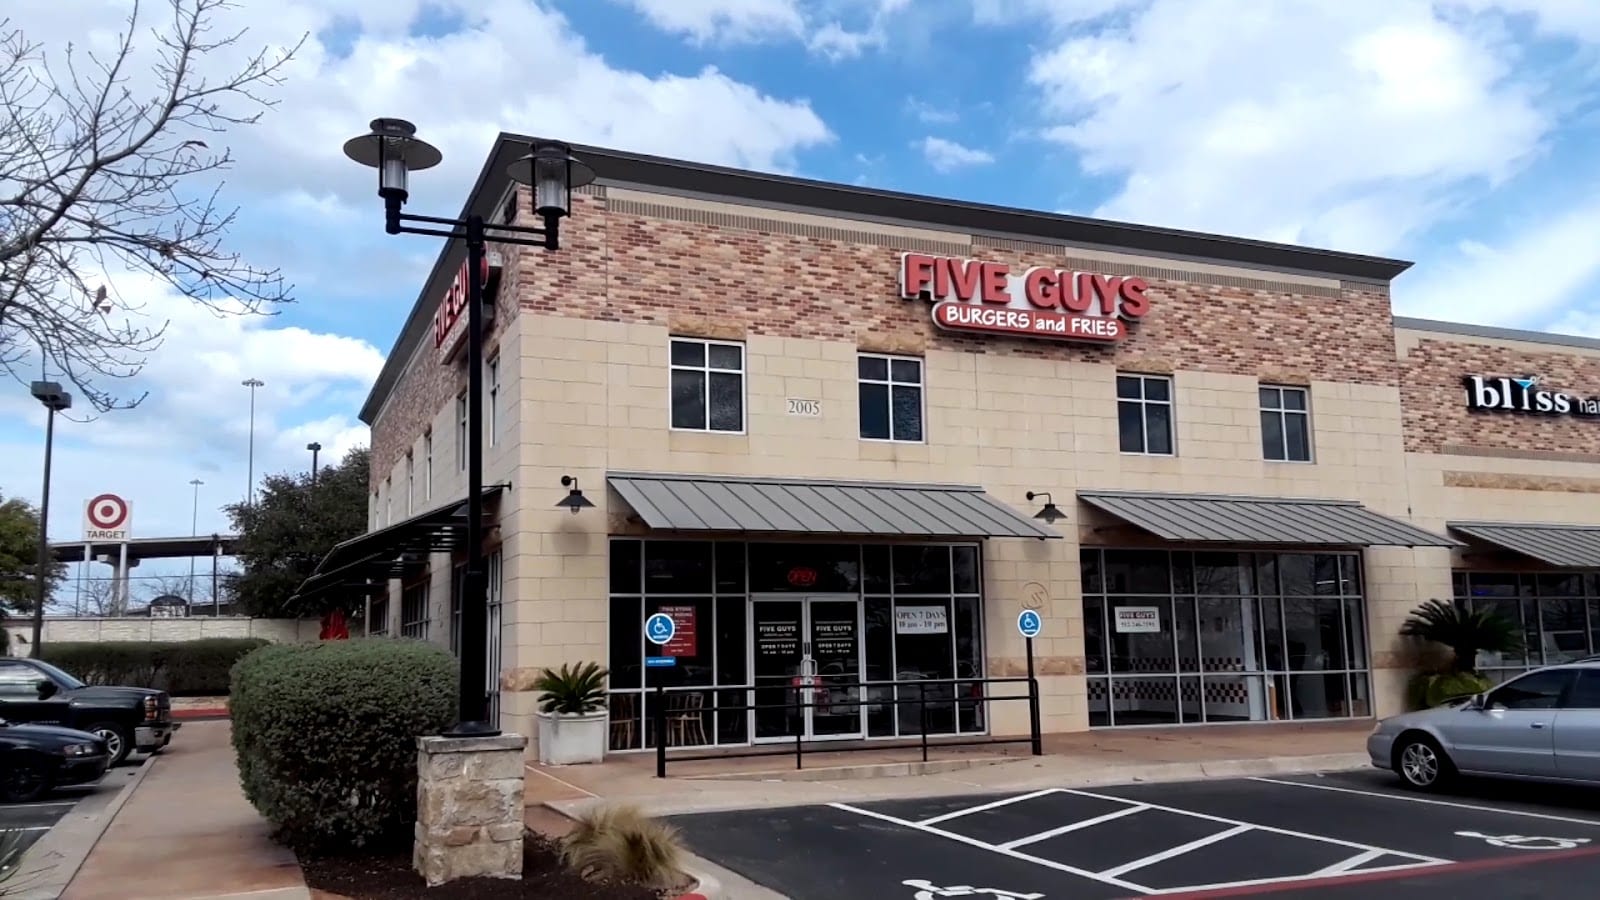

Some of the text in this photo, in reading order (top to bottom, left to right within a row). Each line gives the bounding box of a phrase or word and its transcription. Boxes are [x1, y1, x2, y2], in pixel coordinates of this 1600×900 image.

[904, 253, 1151, 318] FIVE GUYS
[434, 287, 453, 349] FIVE
[946, 305, 1118, 337] BURGERS and FRIES
[788, 400, 820, 415] 2005
[1471, 376, 1571, 413] bliss
[87, 530, 126, 539] TARGET
[919, 611, 923, 619] 7
[926, 611, 946, 619] DAYS
